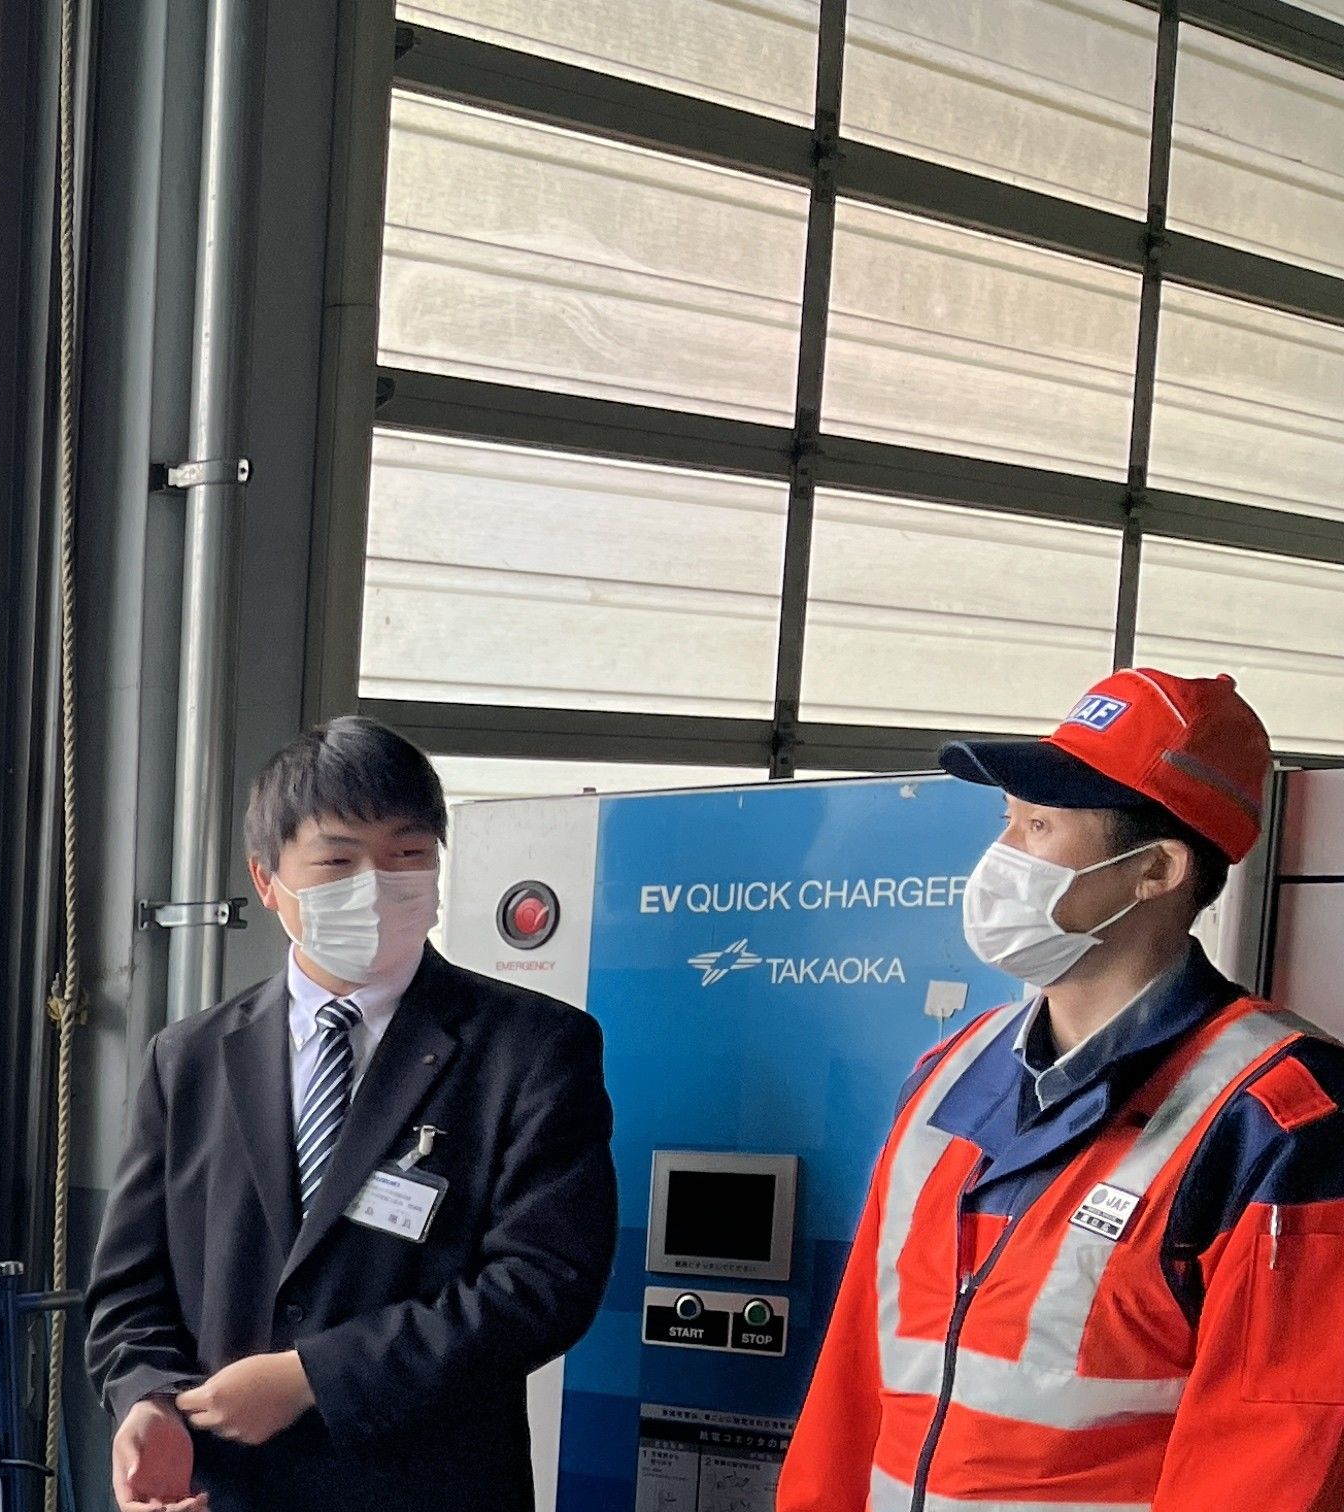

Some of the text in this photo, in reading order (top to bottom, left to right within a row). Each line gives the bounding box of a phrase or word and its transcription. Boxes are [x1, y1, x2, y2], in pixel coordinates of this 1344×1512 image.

[639, 885, 683, 914] EV
[686, 881, 791, 913] QUICK
[495, 960, 556, 972] EMERGENCY
[766, 957, 906, 984] TAKAOKA
[1106, 1196, 1131, 1212] JAF
[669, 1326, 705, 1339] START
[741, 1333, 773, 1345] STOP
